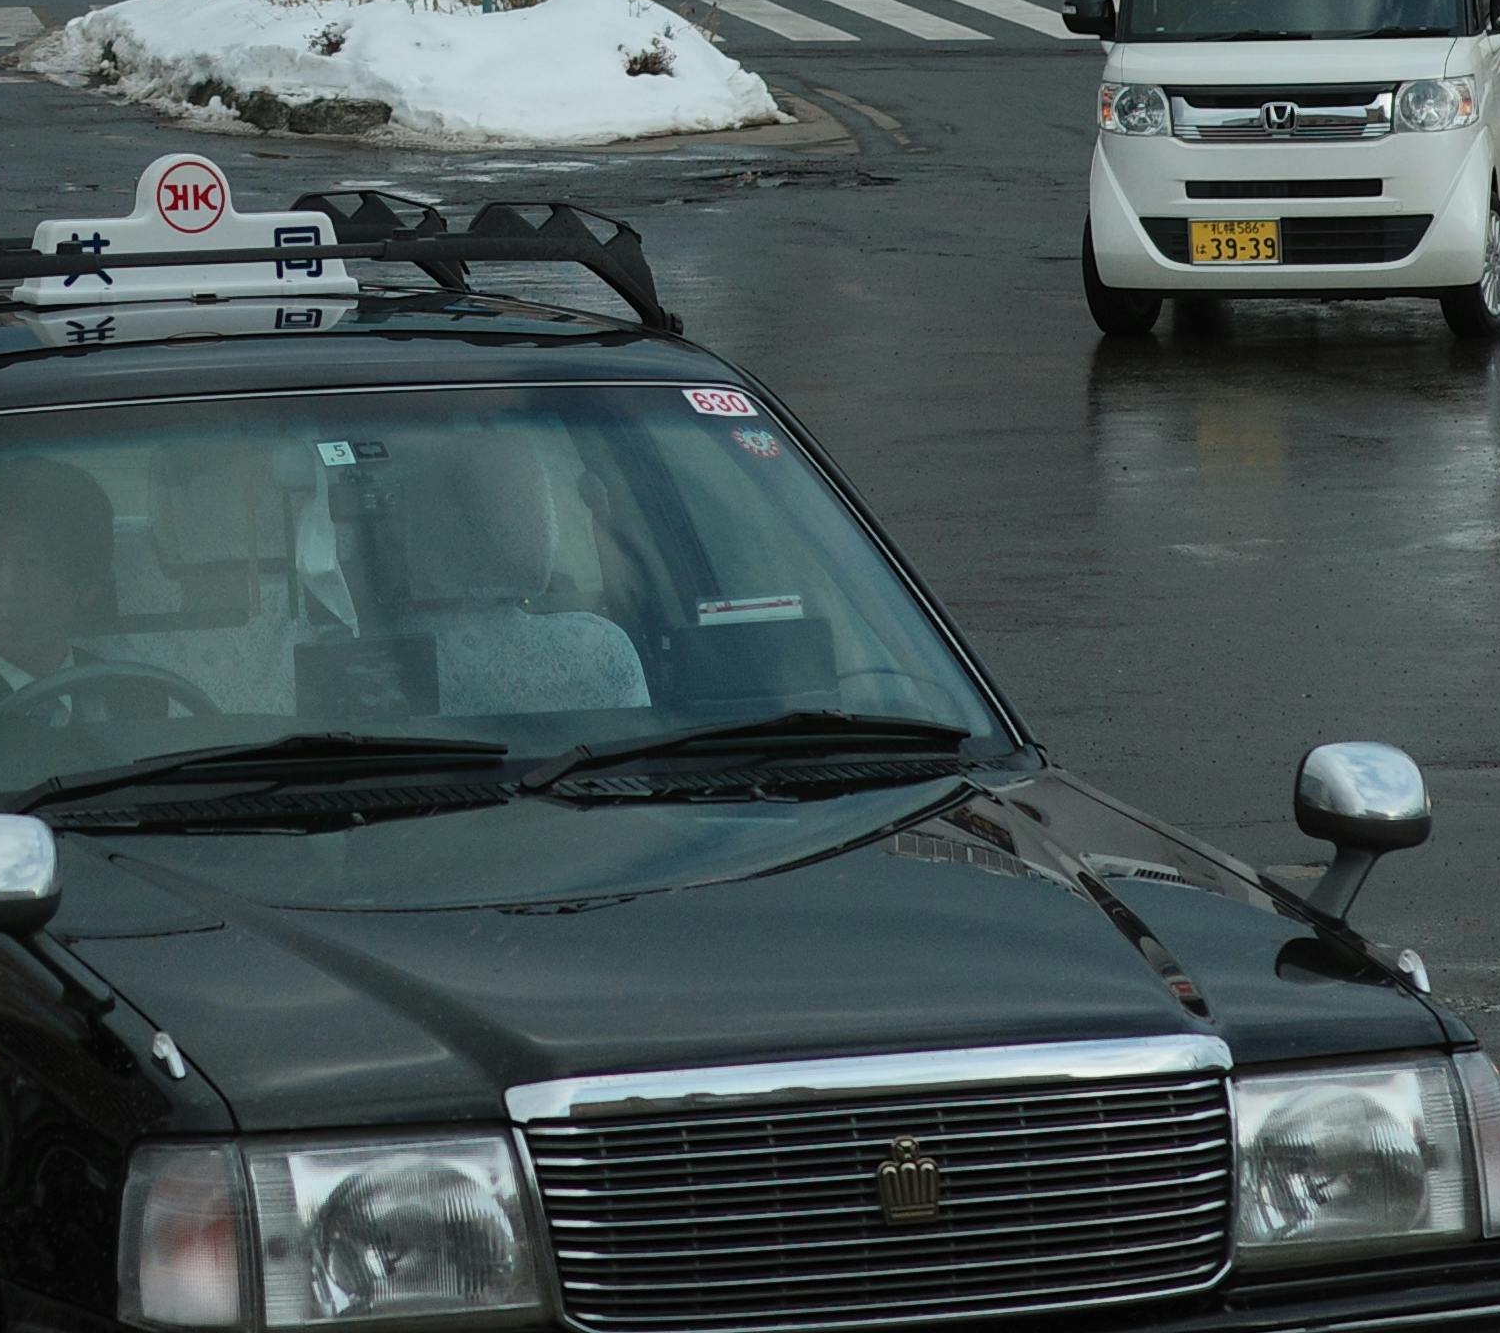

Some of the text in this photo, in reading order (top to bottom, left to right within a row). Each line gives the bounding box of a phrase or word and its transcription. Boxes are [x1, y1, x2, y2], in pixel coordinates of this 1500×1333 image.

[1210, 222, 1260, 235] 札幌586
[1210, 237, 1277, 260] 39-39
[692, 390, 748, 414] 630
[332, 444, 346, 458] 5
